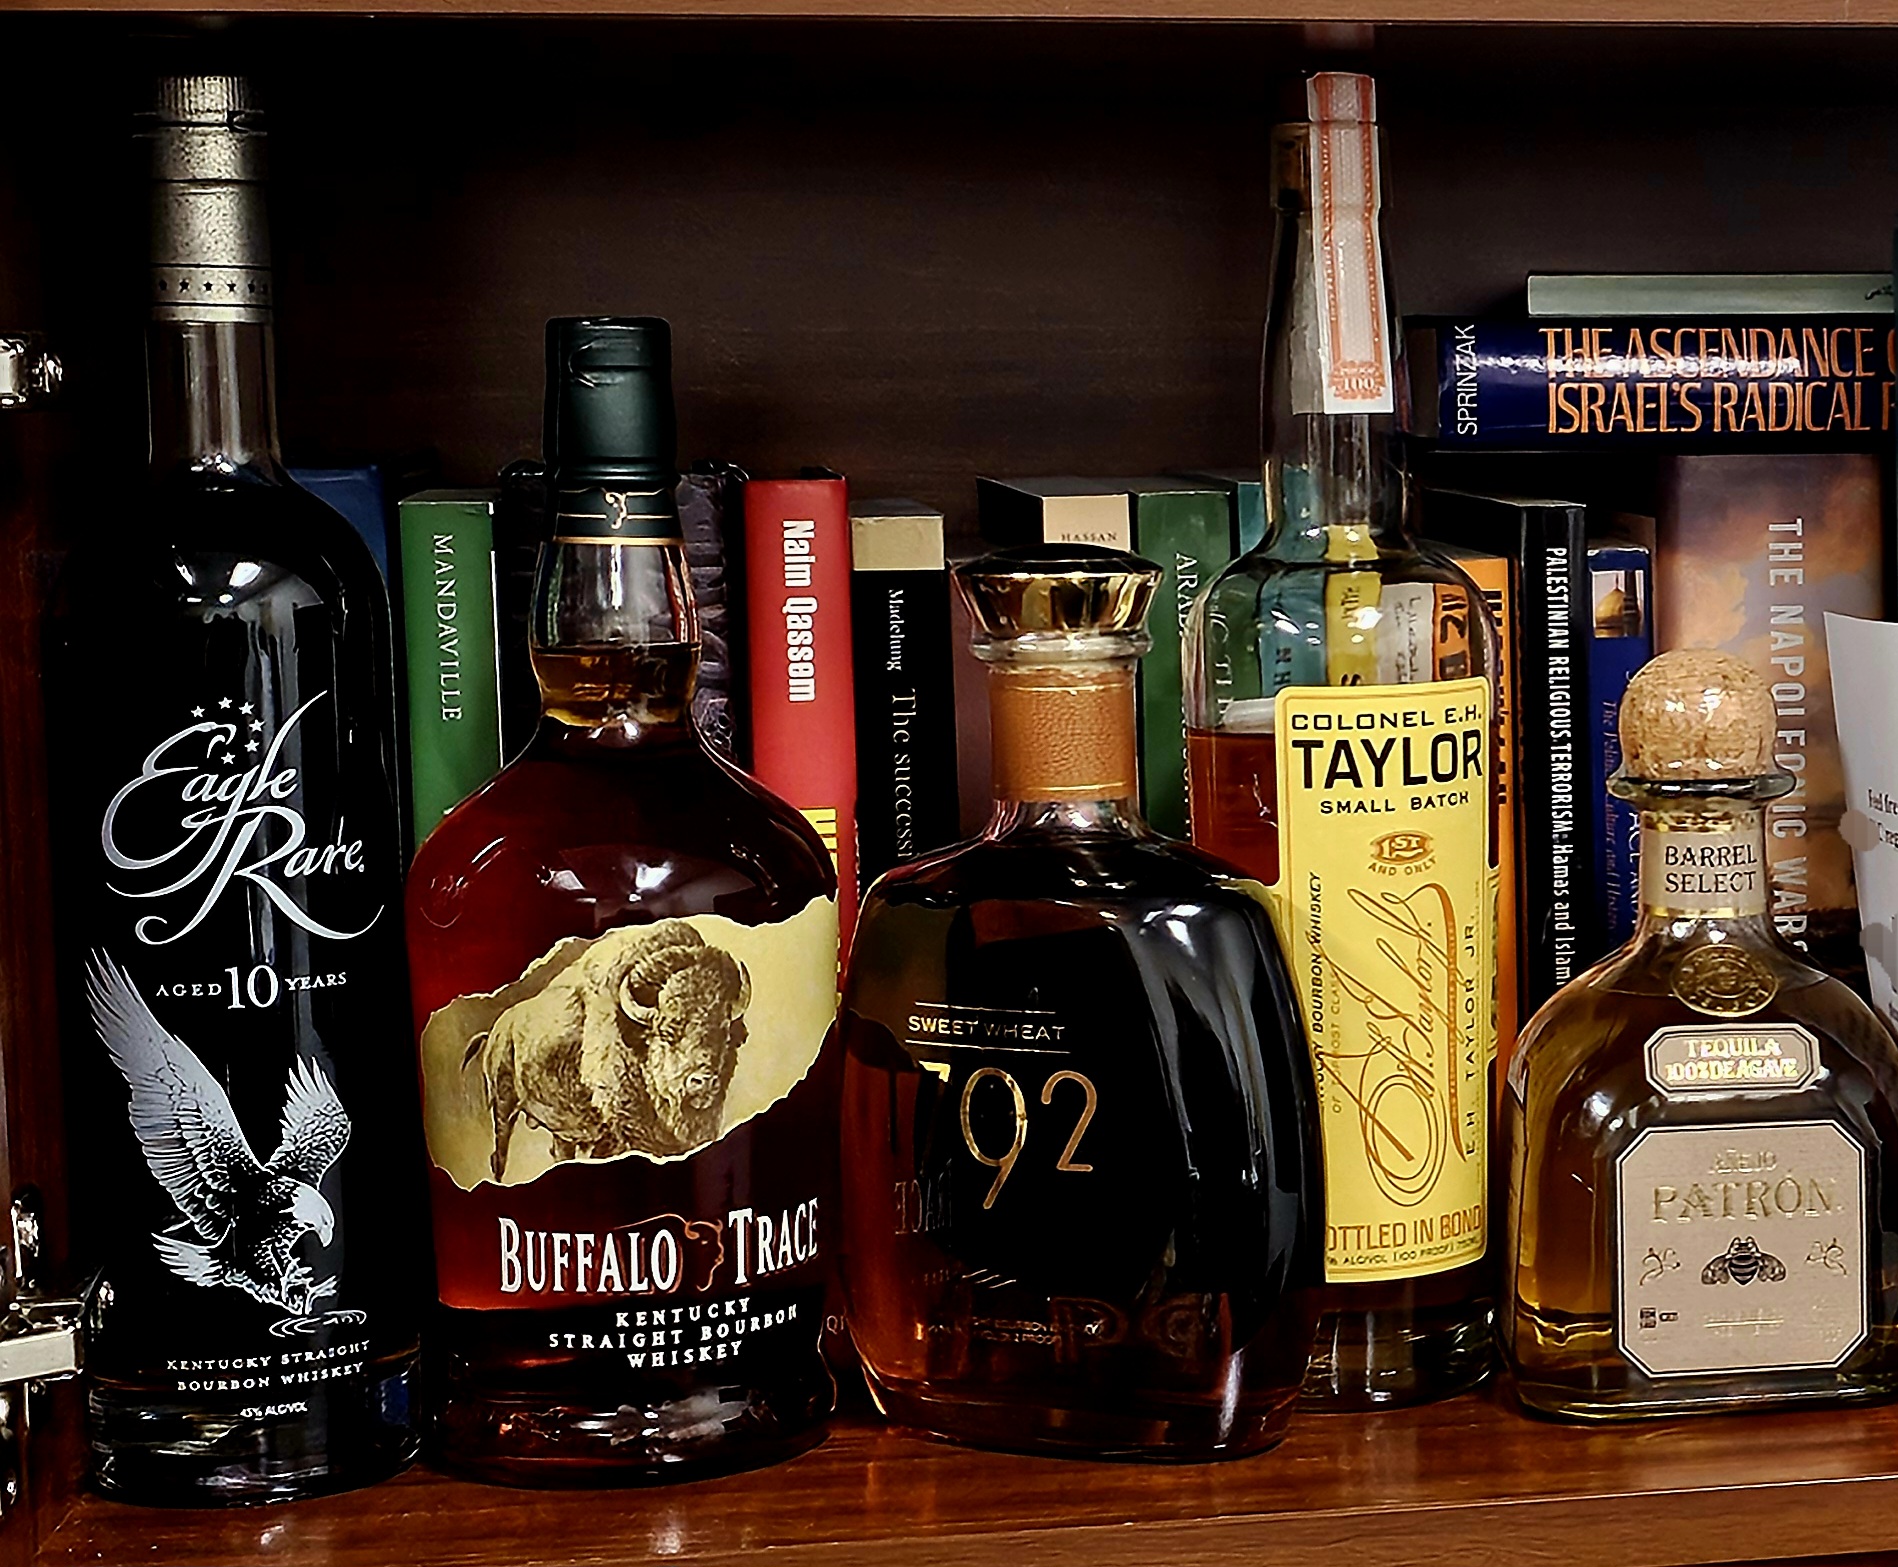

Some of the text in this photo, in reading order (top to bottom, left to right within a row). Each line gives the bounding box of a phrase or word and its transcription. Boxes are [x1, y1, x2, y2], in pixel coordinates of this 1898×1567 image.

[1539, 327, 1875, 378] THE ASCENDANCE
[1454, 324, 1478, 436] SPRINZAK
[1548, 381, 1872, 433] ISRAEL'S RADICAL
[1061, 532, 1118, 543] HASSAN
[1767, 517, 1805, 588] THE
[782, 519, 819, 703] Naim Qassem
[1545, 546, 1569, 650] PALESTINIAN
[433, 534, 463, 722] MANDAVILLE
[890, 687, 916, 731] The
[1292, 704, 1482, 731] COLONEL E.H.
[1548, 653, 1572, 739] RELIGIOUS
[1291, 729, 1484, 790] TAYLOR
[102, 689, 328, 898] Eagle
[1320, 791, 1469, 814] SMALL BATCH
[1368, 856, 1437, 877] AND ONLY
[1552, 842, 1574, 898] Hamas
[1665, 843, 1758, 868] BARREL
[1664, 870, 1757, 894] SELECT
[1464, 914, 1475, 958] JR.
[1553, 900, 1574, 930] and
[156, 964, 347, 1010] AGED 10 YEARS
[908, 1015, 1066, 1042] SWEET WHEAT
[1464, 978, 1476, 1082] TAYLOR
[1686, 1037, 1783, 1058] TEQUILA
[497, 1197, 820, 1294] BUFFALO TRACE
[1413, 1217, 1434, 1245] IN
[1440, 1204, 1482, 1241] BOND
[548, 1303, 798, 1350] STRAIGHT BOURBON
[615, 1297, 751, 1328] KENTUCKY
[167, 1355, 272, 1371] KENTUCKY
[177, 1361, 364, 1392] BOURBON WHISKEY
[626, 1340, 743, 1369] WHISKEY
